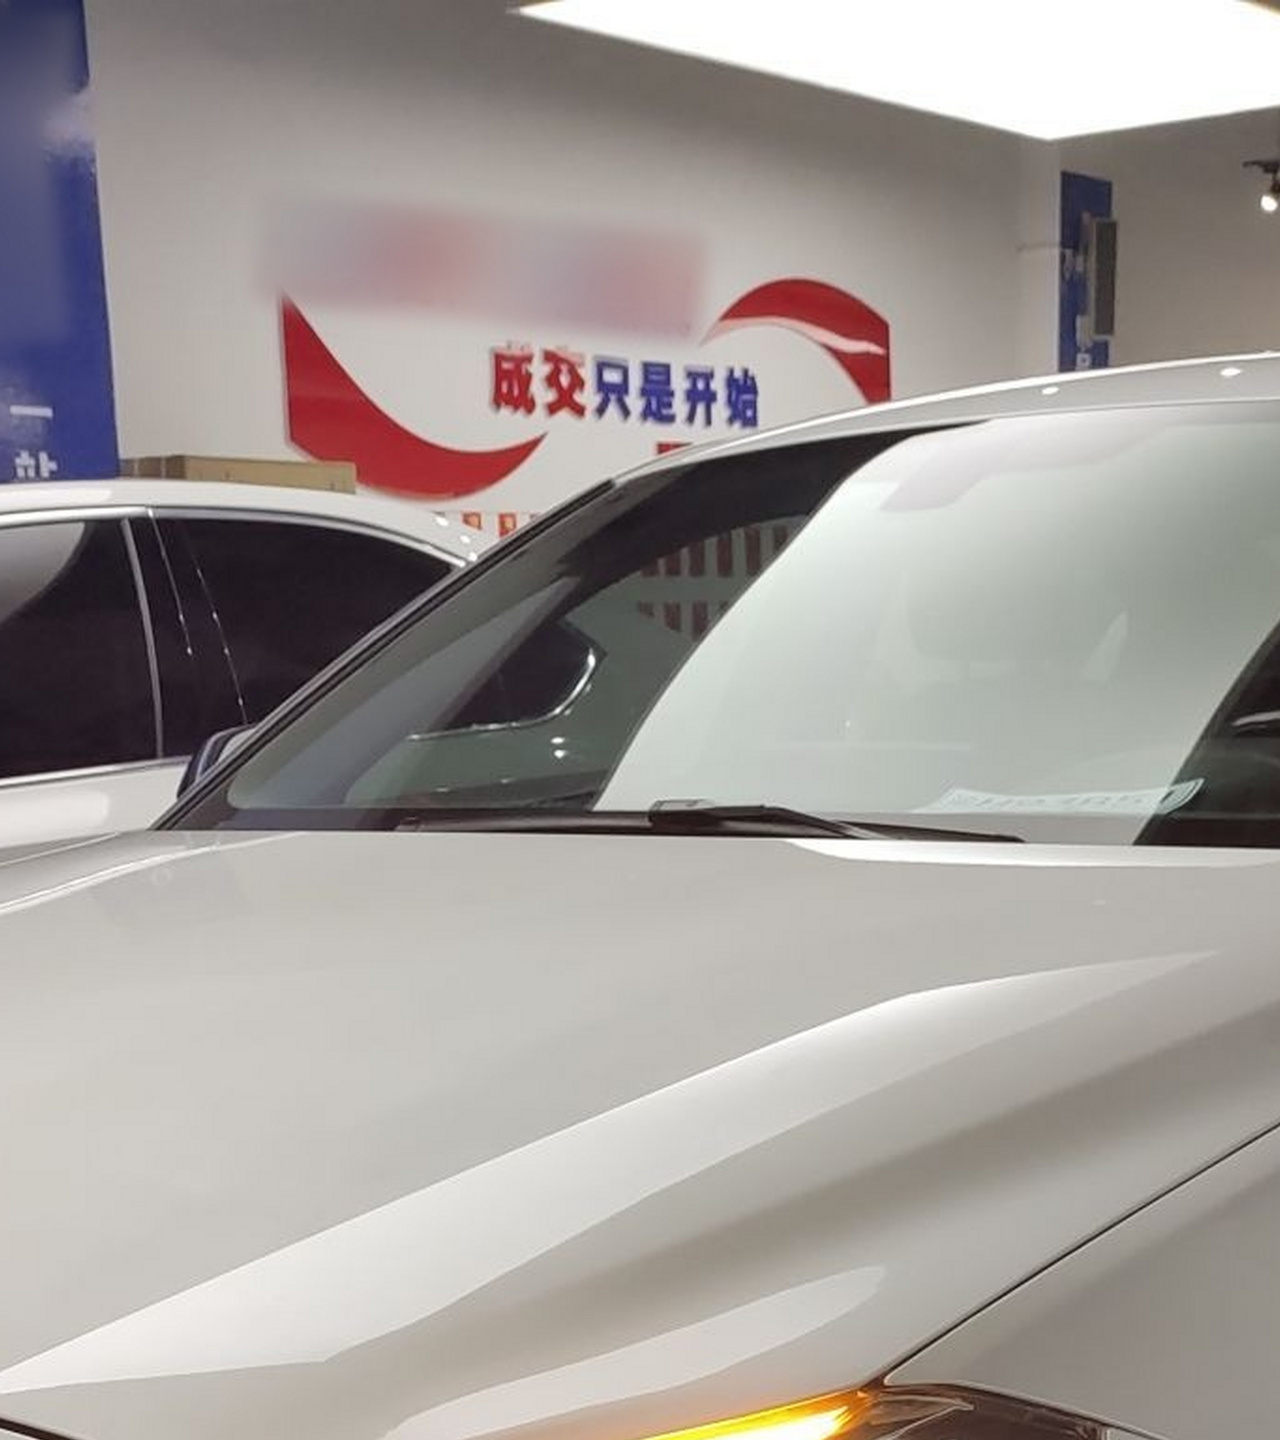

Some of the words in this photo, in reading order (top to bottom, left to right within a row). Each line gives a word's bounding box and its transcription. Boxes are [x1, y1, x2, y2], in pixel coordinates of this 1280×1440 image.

[492, 346, 758, 427] 成交只是开始
